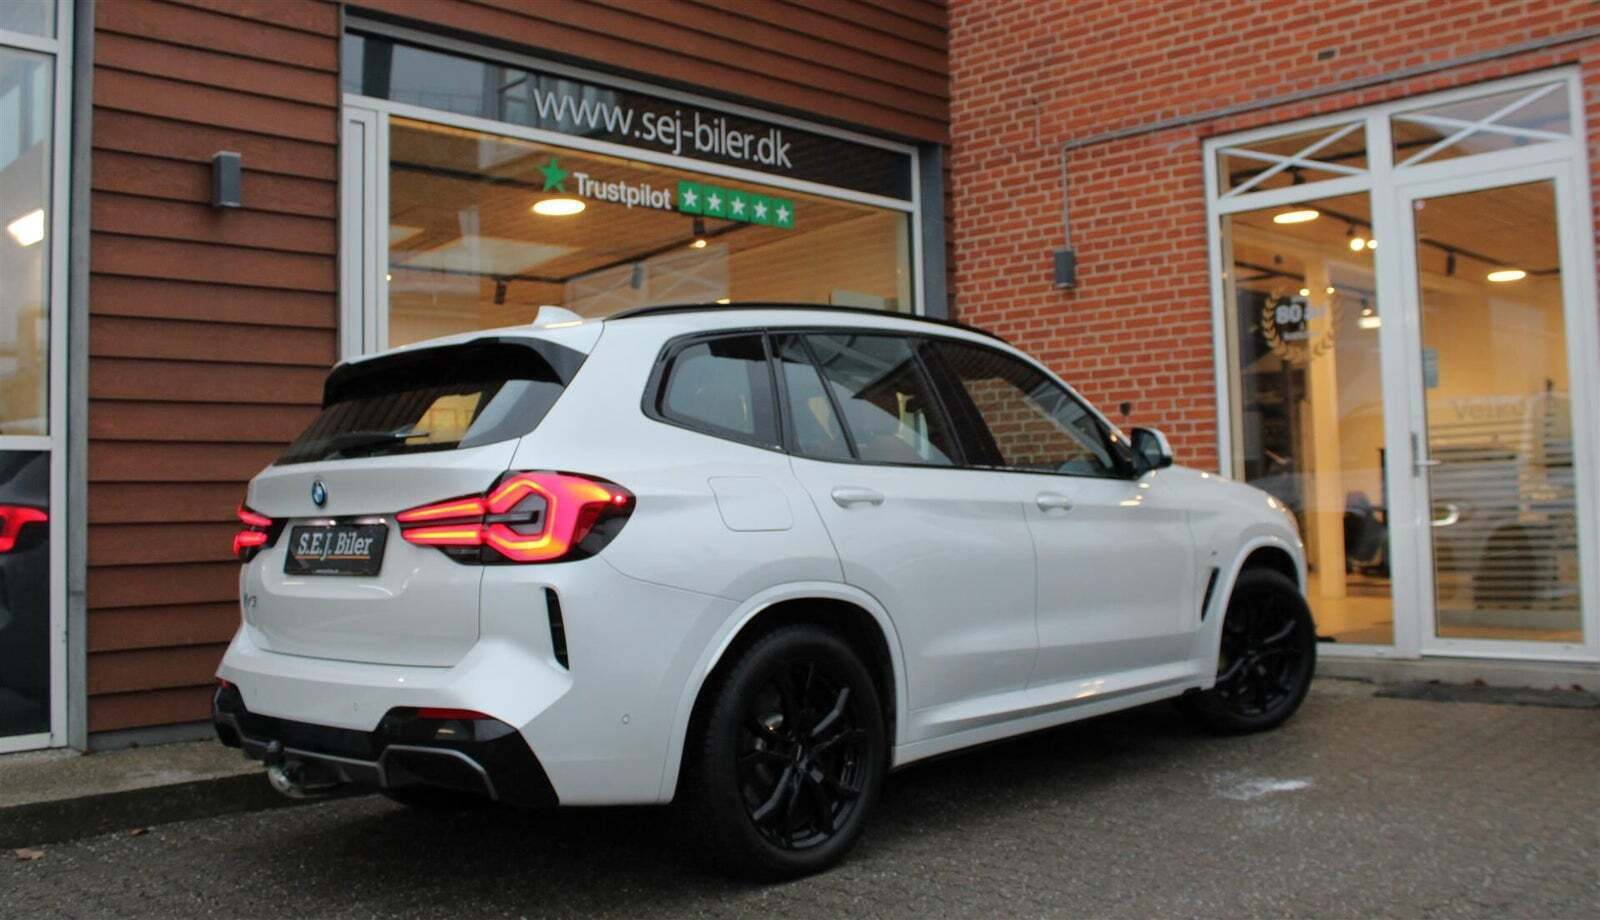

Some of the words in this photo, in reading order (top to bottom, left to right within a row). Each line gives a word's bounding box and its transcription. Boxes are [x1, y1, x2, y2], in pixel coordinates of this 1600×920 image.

[533, 87, 793, 170] www.sej-biler.dk
[573, 171, 672, 210] Trustpilot
[297, 530, 332, 561] S.E.J.
[334, 532, 374, 555] Biler
